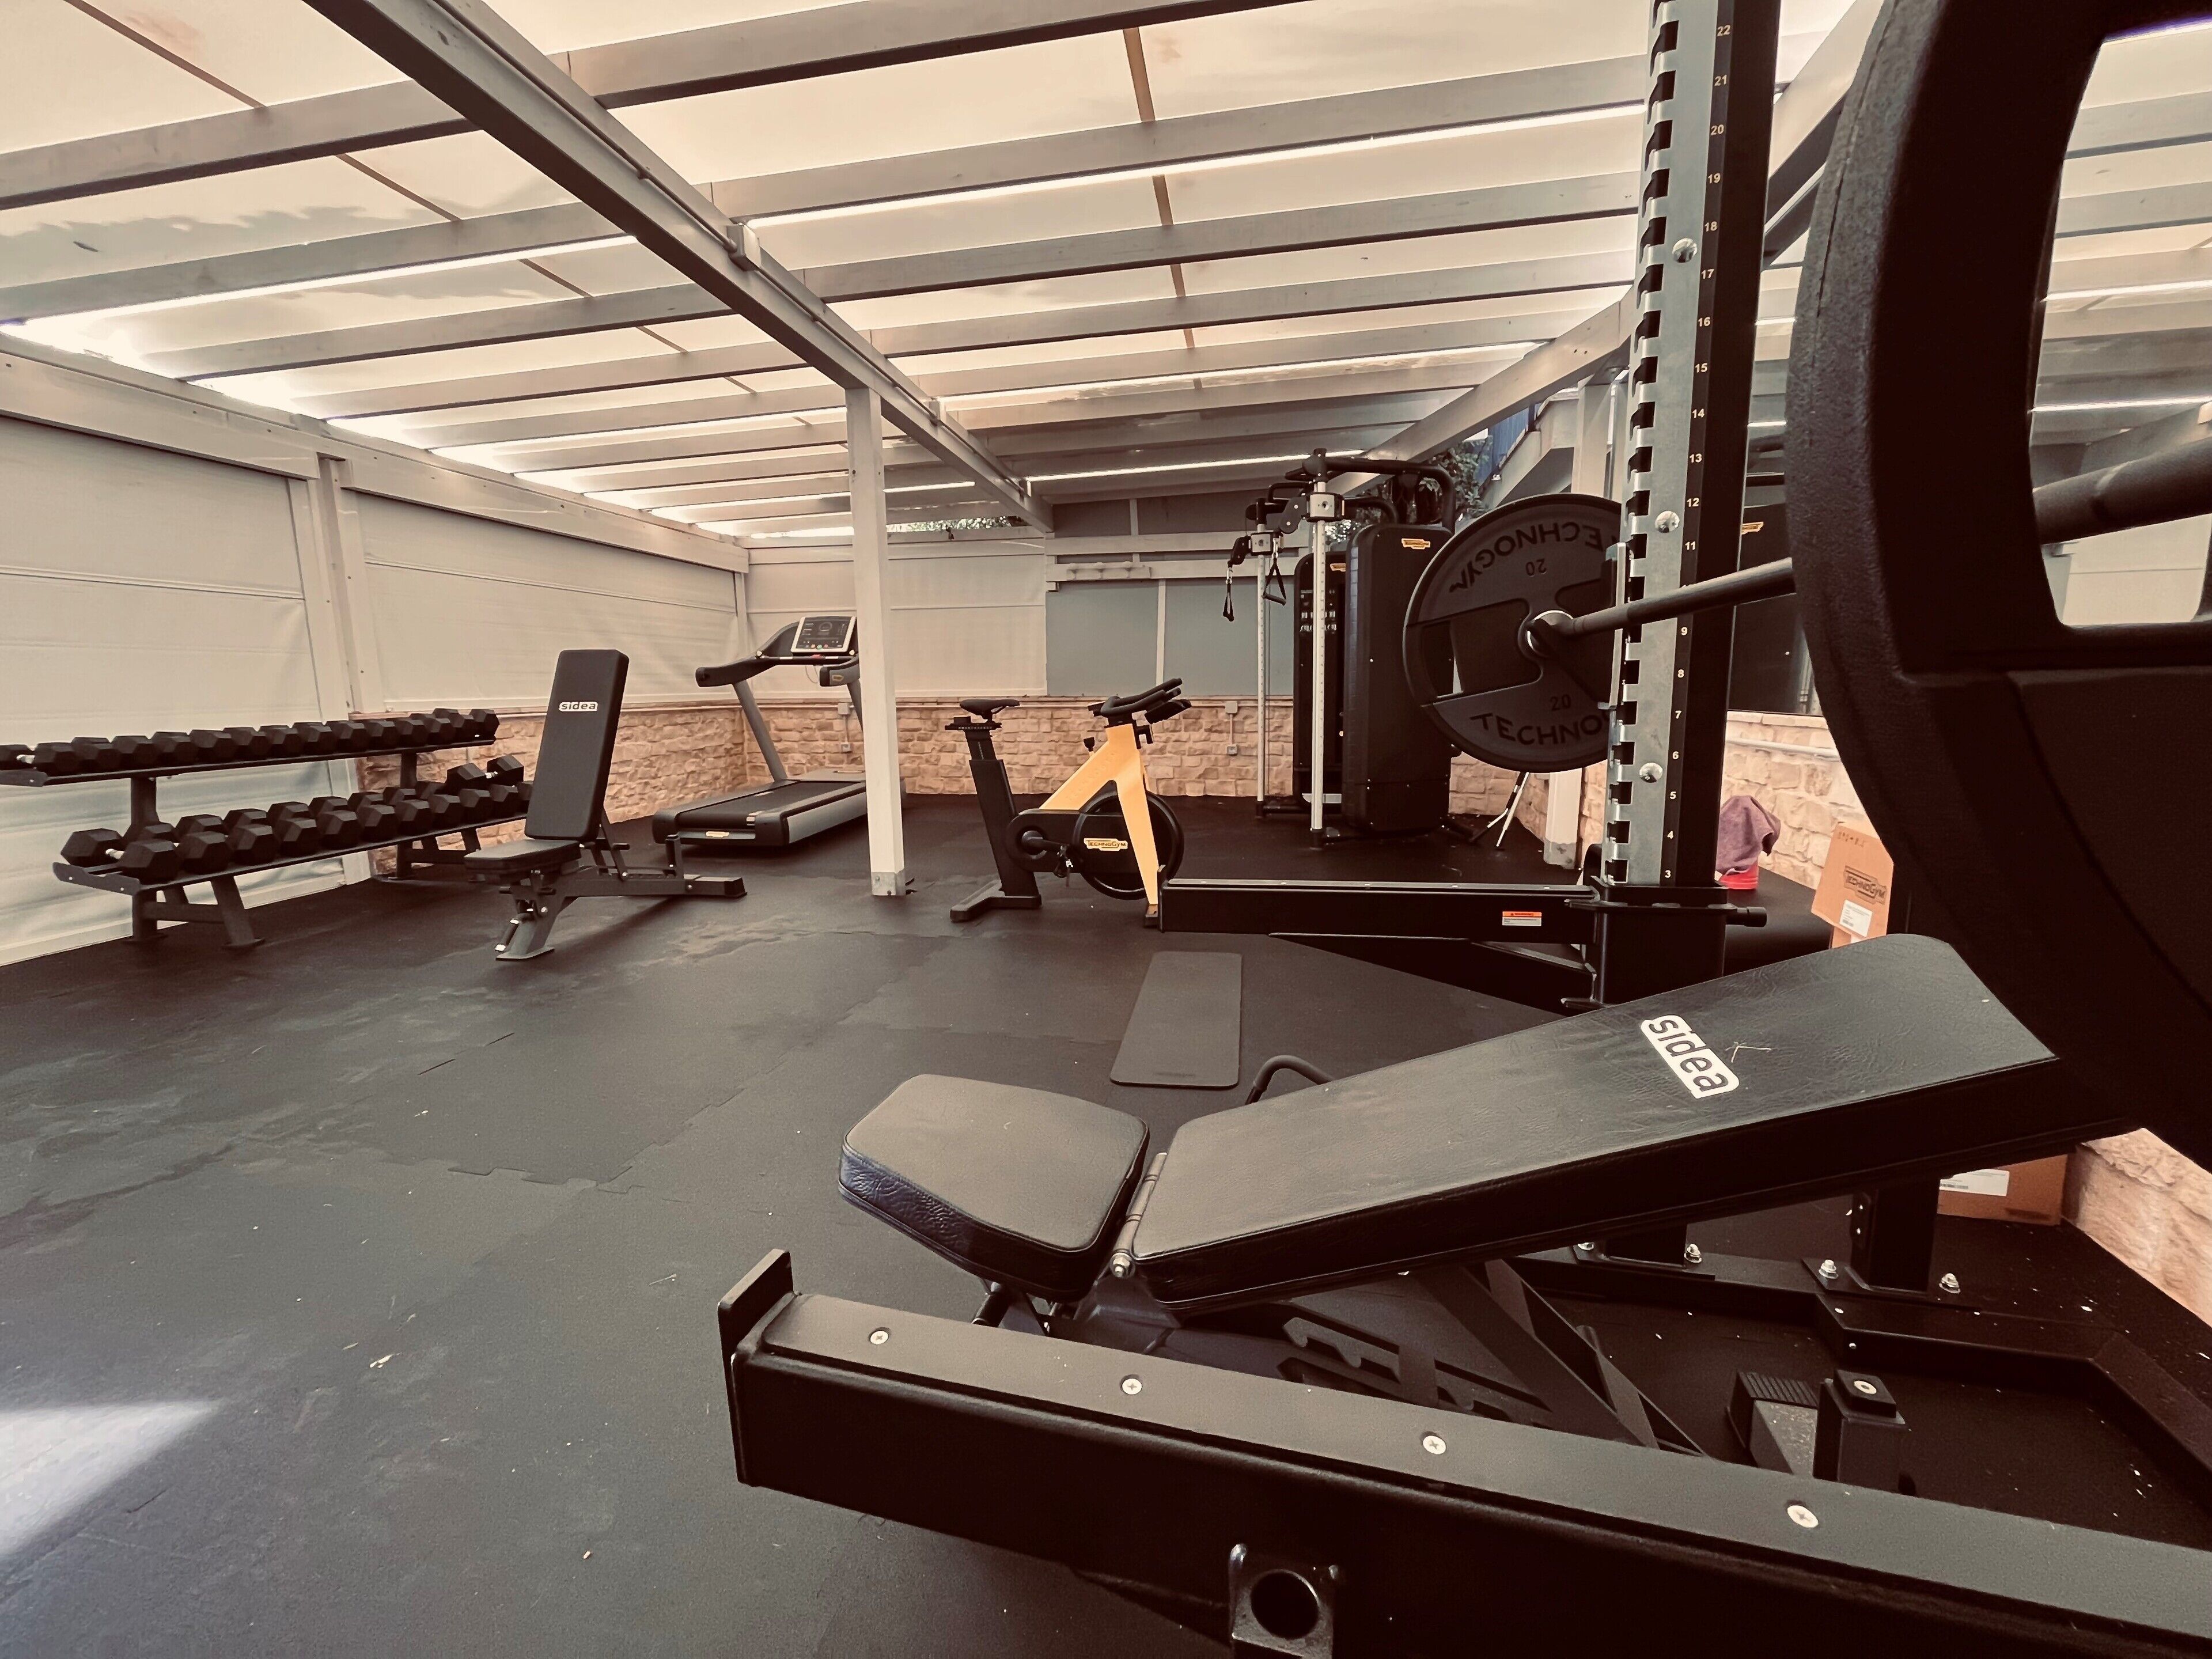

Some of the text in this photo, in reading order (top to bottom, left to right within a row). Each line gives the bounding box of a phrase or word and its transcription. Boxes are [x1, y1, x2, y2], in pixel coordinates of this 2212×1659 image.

[1717, 25, 1731, 36] 22
[1714, 74, 1728, 86] 21
[1710, 124, 1724, 136] 20
[1707, 173, 1721, 184] 19
[1705, 221, 1717, 232] 18
[1701, 268, 1715, 279] 17
[1698, 316, 1711, 327] 16
[1695, 362, 1708, 373] 15
[1692, 408, 1705, 419] 14
[1689, 453, 1703, 464] 13
[1687, 497, 1699, 508] 12
[1684, 541, 1696, 551] 11
[1525, 558, 1547, 577] 20
[1681, 627, 1688, 636] 9
[1677, 669, 1684, 678] 8
[561, 701, 596, 710] sidea
[1548, 694, 1571, 711] 20
[1675, 710, 1682, 719] 7
[1469, 710, 1610, 745] TECHNO
[1672, 751, 1679, 760] 6
[1669, 791, 1676, 800] 5
[1666, 831, 1674, 839] 4
[1665, 870, 1672, 879] 3
[1648, 1019, 1729, 1092] sidea
